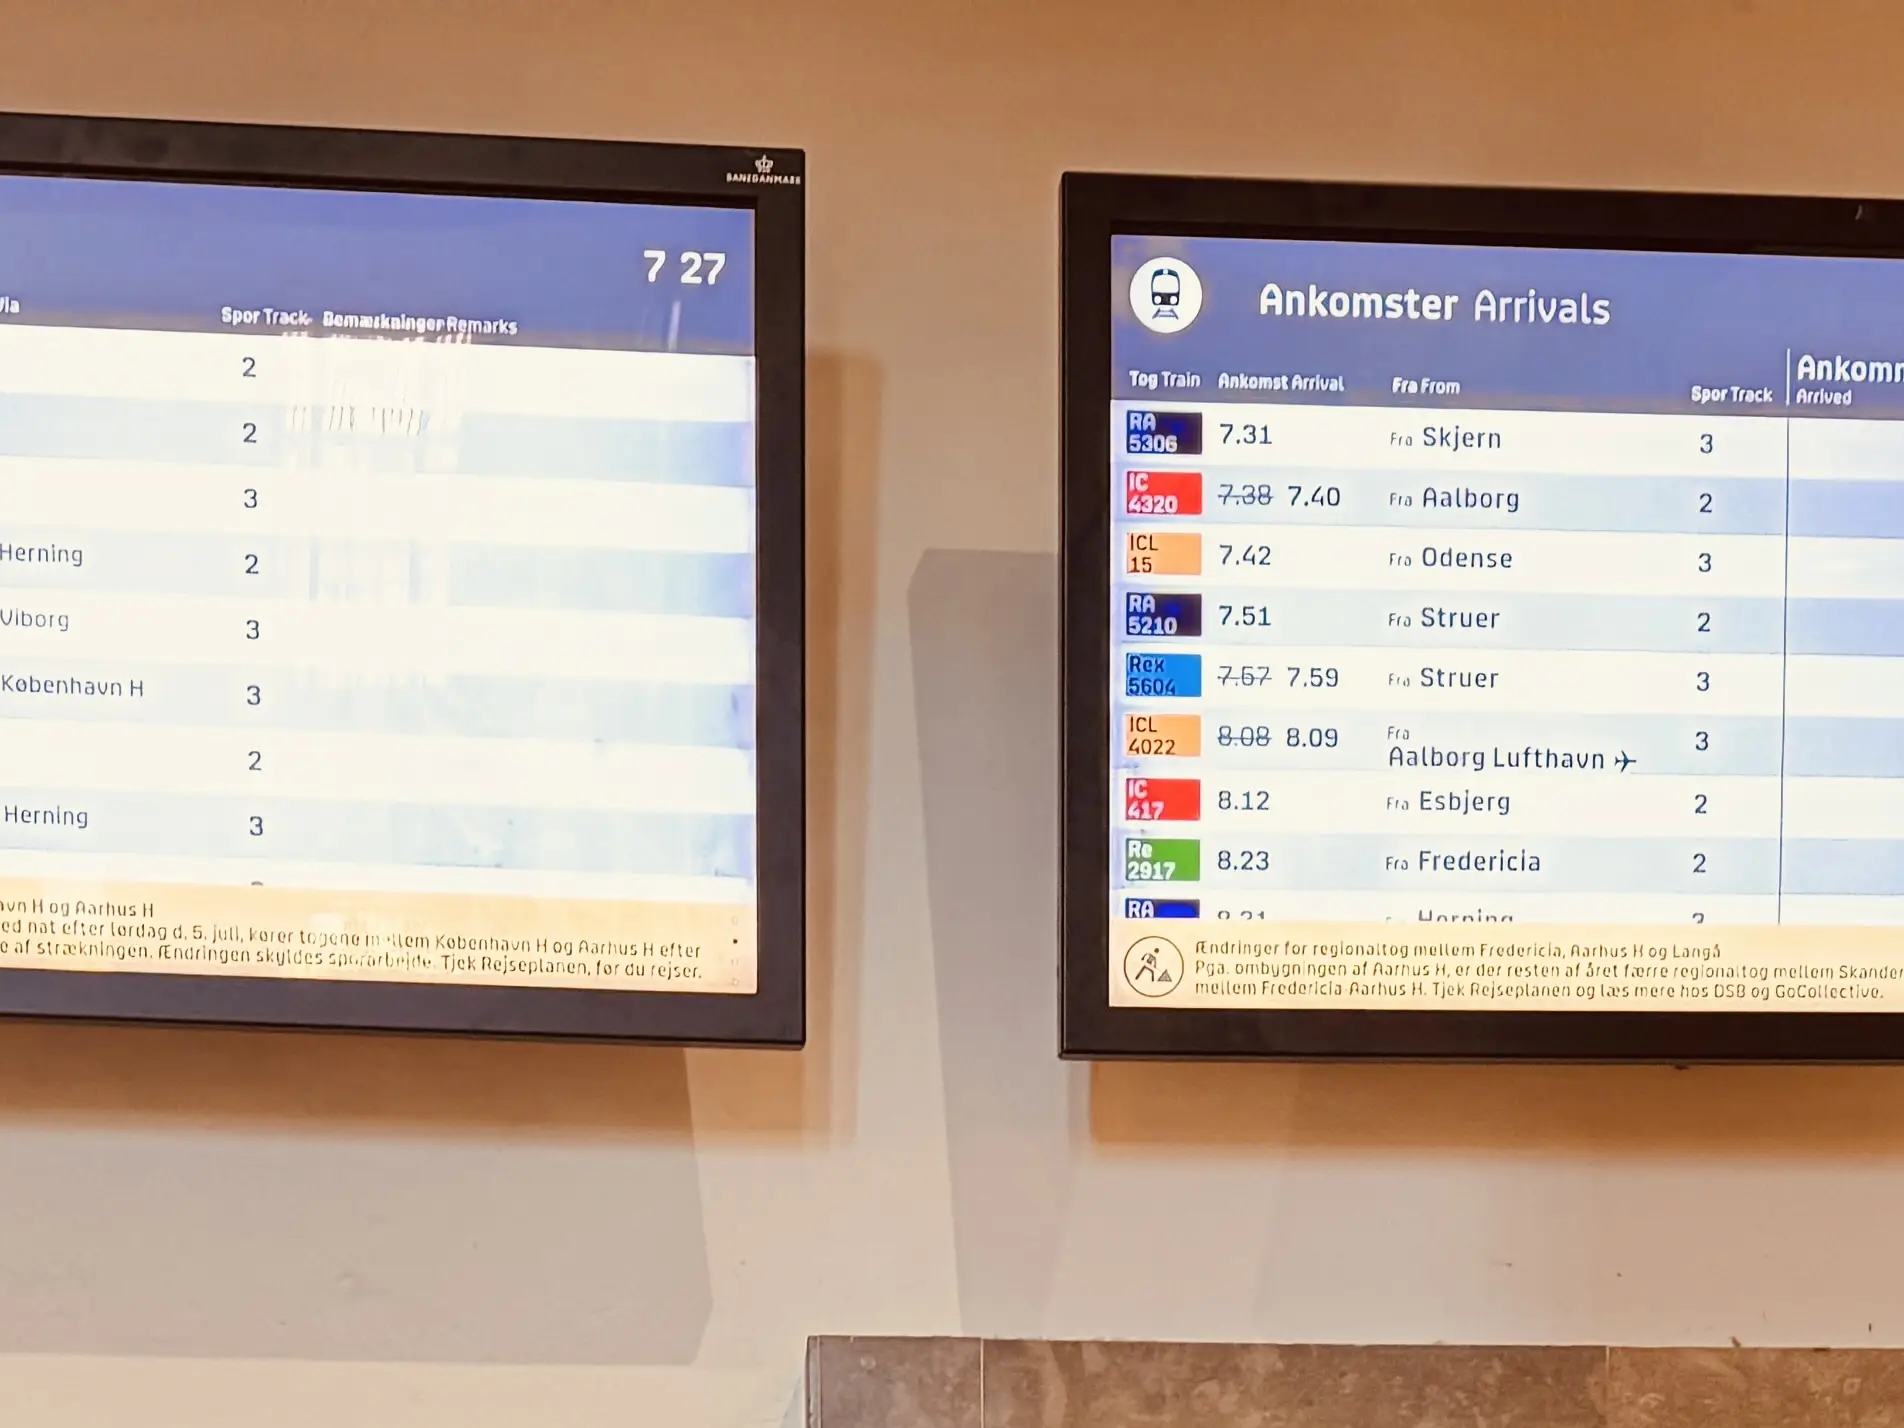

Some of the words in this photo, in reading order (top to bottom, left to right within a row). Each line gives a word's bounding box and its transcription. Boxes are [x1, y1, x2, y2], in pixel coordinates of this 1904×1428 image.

[222, 306, 260, 325] Spor
[264, 308, 308, 326] Track
[1261, 284, 1458, 320] Ankomster
[1475, 289, 1610, 324] Arrivals
[1797, 388, 1851, 407] Arrived
[1129, 434, 1177, 454] 5306
[1130, 412, 1155, 432] RA
[1220, 424, 1272, 444] 7.31
[1424, 426, 1500, 451] Skjern
[1701, 434, 1712, 453] 3
[1128, 494, 1177, 514] 4320
[1129, 472, 1148, 492] IC
[1289, 486, 1340, 506] 7.40
[1424, 488, 1518, 512] Aalborg
[1700, 494, 1712, 512] 2
[0, 544, 82, 567] Herning
[245, 554, 258, 574] 2
[1130, 534, 1158, 552] ICL
[1220, 545, 1270, 565] 7.42
[1423, 547, 1512, 568] Odense
[1699, 553, 1711, 572] 3
[1130, 554, 1153, 574] 15
[0, 610, 68, 631] Viborg
[247, 620, 259, 639] 3
[1220, 606, 1270, 625] 7.51
[1422, 608, 1499, 628] Struer
[1128, 654, 1165, 674] Rex
[1288, 667, 1338, 687] 7.59
[1421, 668, 1498, 688] Struer
[1697, 672, 1709, 691] 3
[0, 673, 122, 697] København
[131, 680, 143, 696] H
[247, 686, 260, 705] 3
[1129, 716, 1157, 734] ICL
[1287, 728, 1337, 747] 8.09
[1696, 732, 1708, 750] 3
[249, 751, 261, 770] 2
[1128, 737, 1176, 756] 4022
[1390, 747, 1484, 771] Aalborg
[1494, 747, 1603, 768] Lufthavn
[1219, 791, 1269, 810] 8.12
[1421, 790, 1509, 815] Esbjerg
[5, 806, 87, 828] Herning
[250, 816, 263, 836] 3
[1218, 851, 1268, 870] 8.23
[1420, 849, 1539, 871] Fredericia
[1694, 854, 1705, 872] 2
